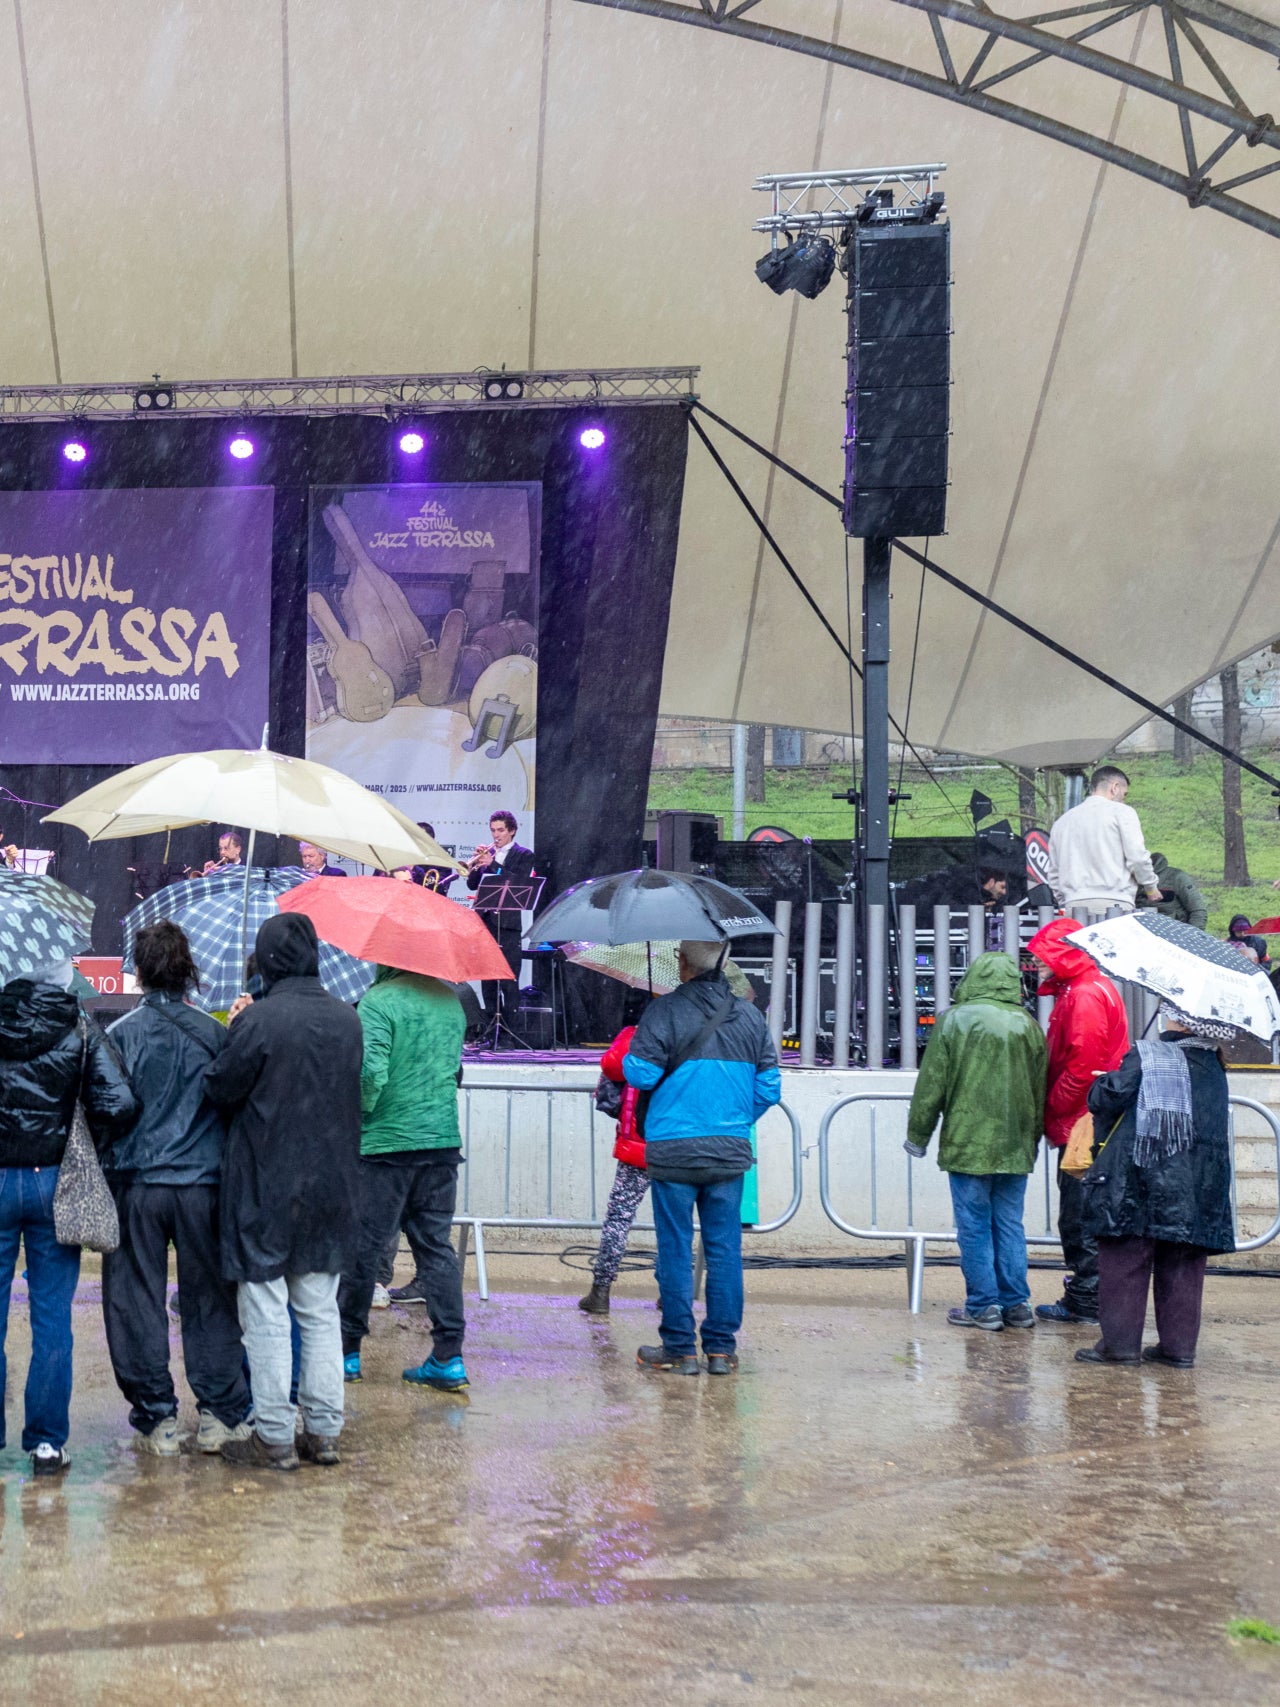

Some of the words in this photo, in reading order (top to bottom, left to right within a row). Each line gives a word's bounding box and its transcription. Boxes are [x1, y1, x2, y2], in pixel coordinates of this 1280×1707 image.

[876, 208, 915, 218] GUIL
[406, 516, 459, 531] FESTIVAL
[368, 531, 411, 549] JAZZ
[412, 530, 495, 549] TERRASSA
[10, 683, 200, 701] WWW.JAZZTERRASSA.ORG
[390, 784, 407, 793] 2025
[416, 783, 502, 792] WWW.JAZZTERRASSA.ORG
